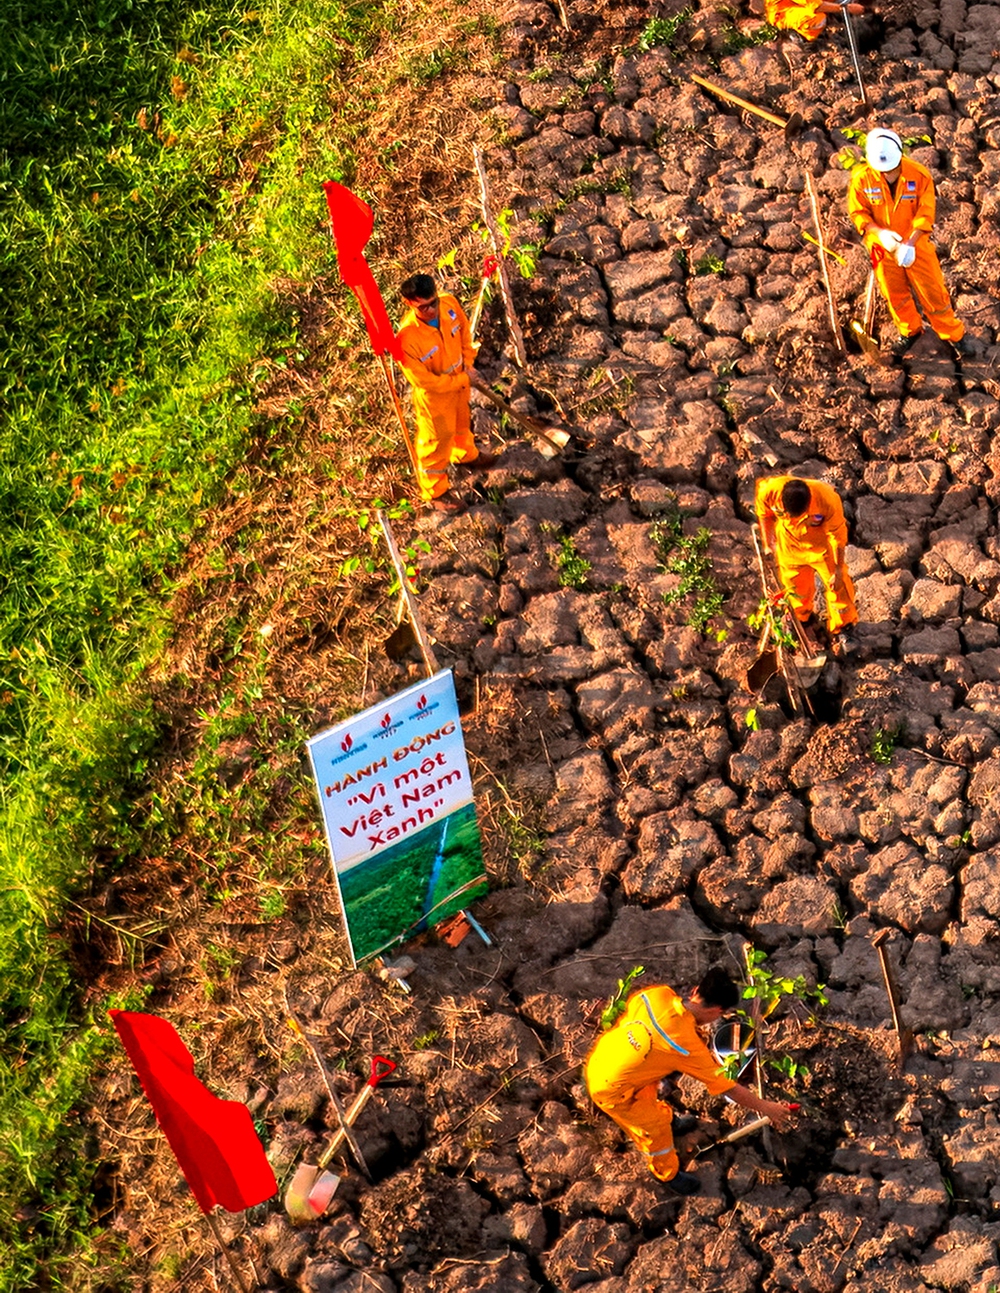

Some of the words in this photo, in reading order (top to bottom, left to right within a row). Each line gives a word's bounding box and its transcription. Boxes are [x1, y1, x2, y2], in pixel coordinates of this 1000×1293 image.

[325, 756, 389, 798] HÀNH
[392, 720, 456, 762] ĐỘNG
[393, 752, 447, 789] một
[339, 803, 395, 838] Việt
[401, 769, 462, 808] Nam
[367, 797, 444, 851] Xanh"
